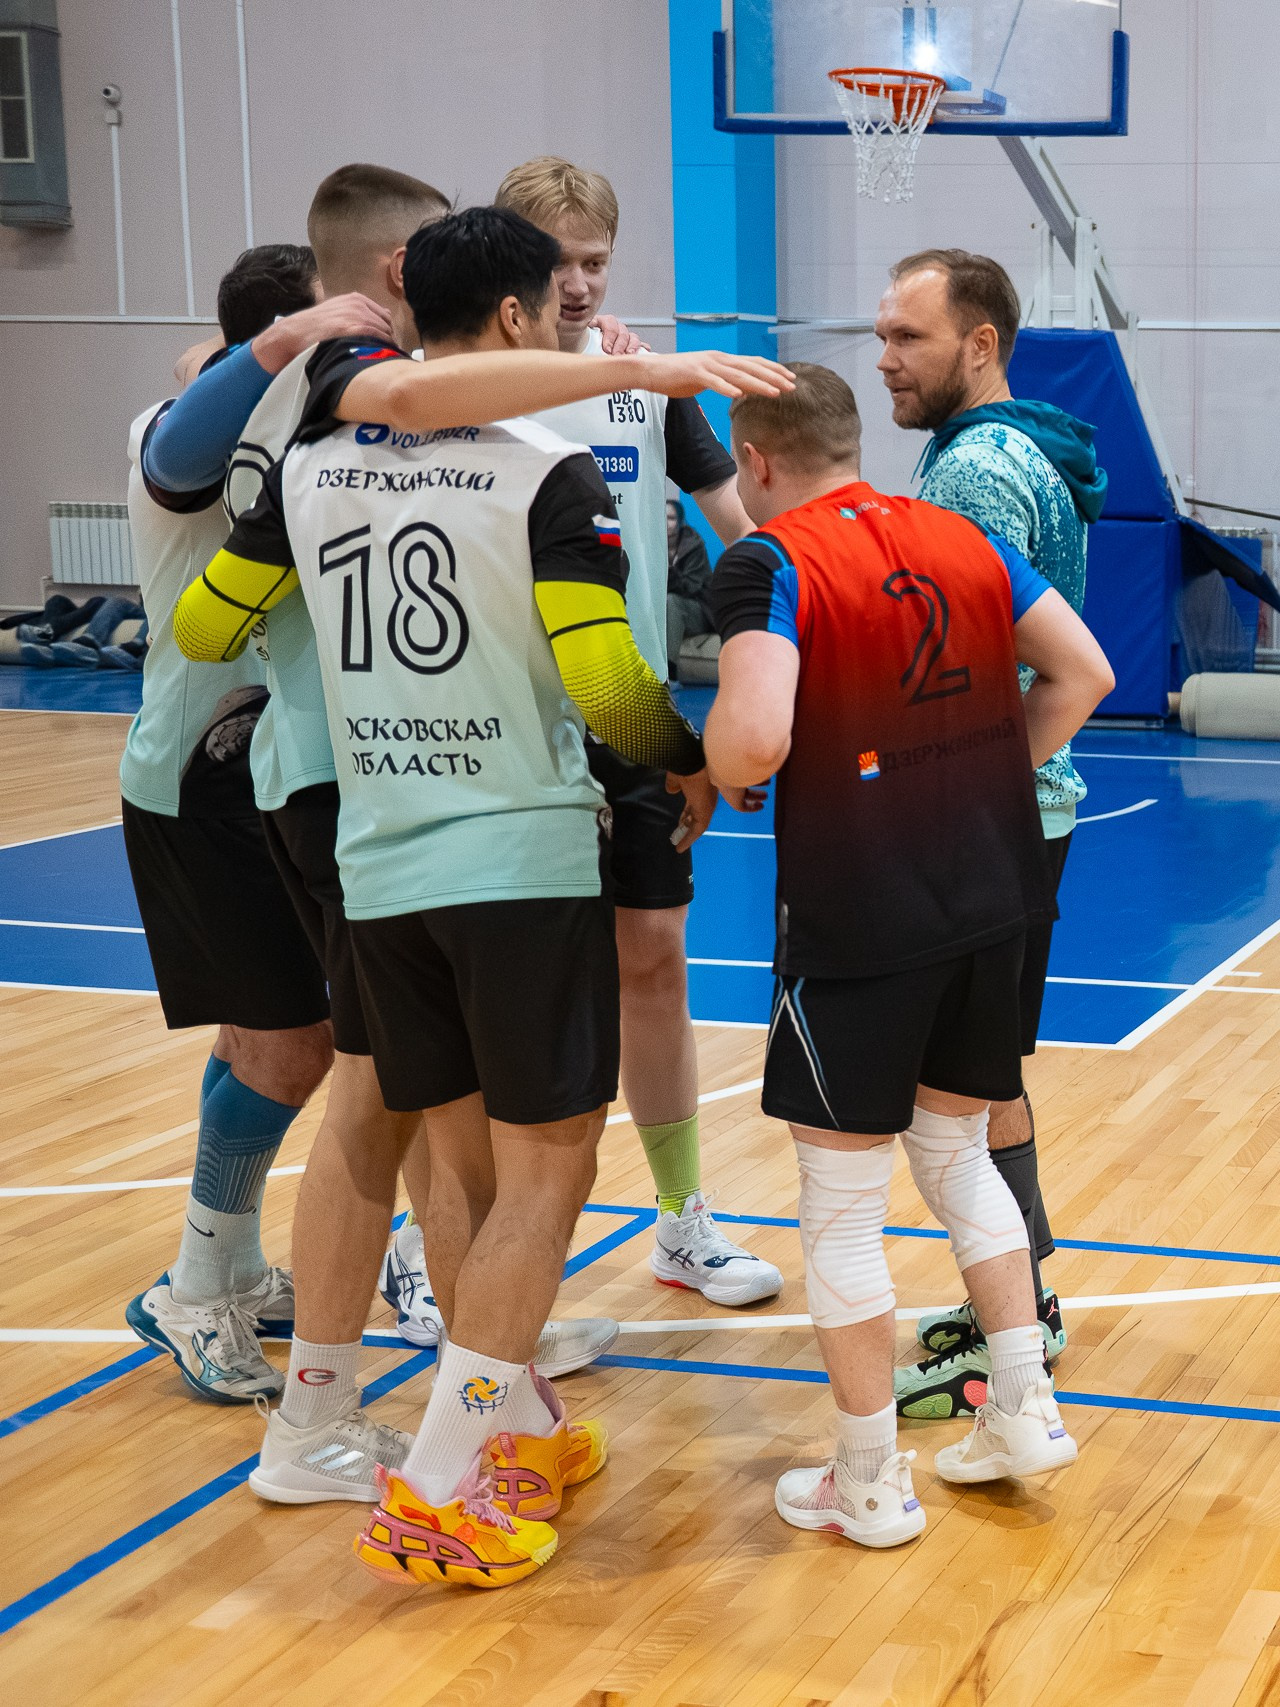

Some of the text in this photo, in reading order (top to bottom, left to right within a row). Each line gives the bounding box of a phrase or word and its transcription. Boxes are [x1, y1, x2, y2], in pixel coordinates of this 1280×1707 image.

[608, 398, 646, 424] 1380
[316, 466, 496, 492] ДЗЕРЖИНСКИЙ
[319, 521, 470, 675] 18
[881, 568, 972, 707] 2
